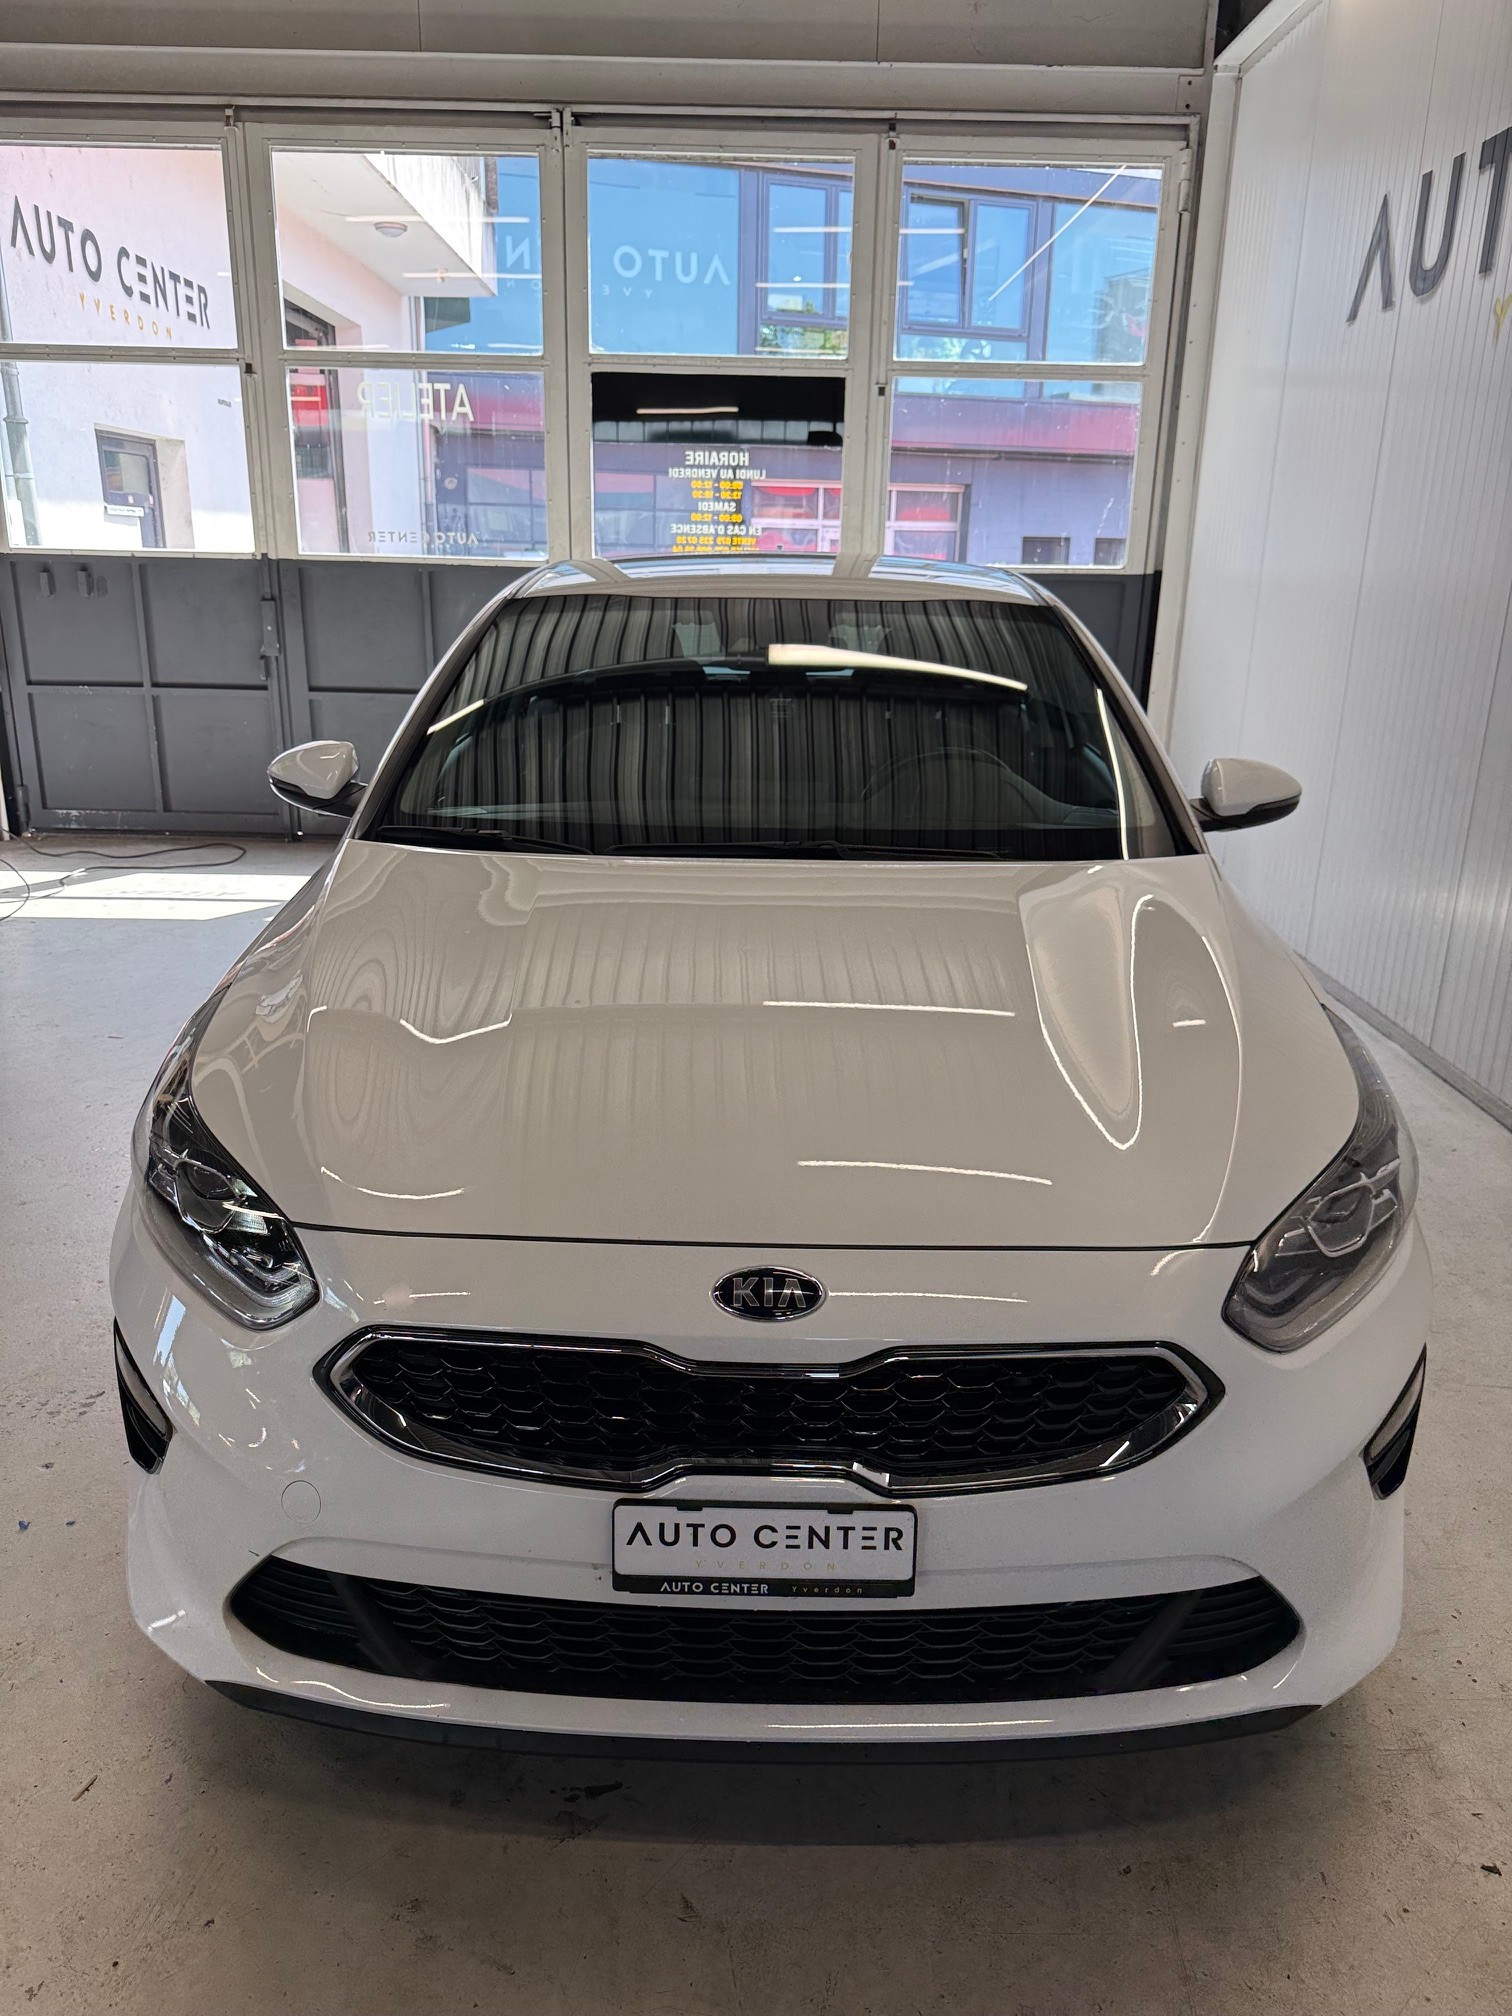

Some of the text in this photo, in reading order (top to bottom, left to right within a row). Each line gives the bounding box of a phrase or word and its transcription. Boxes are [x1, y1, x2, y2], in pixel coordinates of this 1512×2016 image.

[10, 195, 211, 330] AUTO CENTER
[79, 291, 173, 341] YVERDON
[733, 1277, 806, 1307] KIA
[626, 1521, 904, 1551] AUTO CENTER
[696, 1560, 836, 1571] YVERDON
[660, 1581, 863, 1594] AUTO CENTER Yverdon
